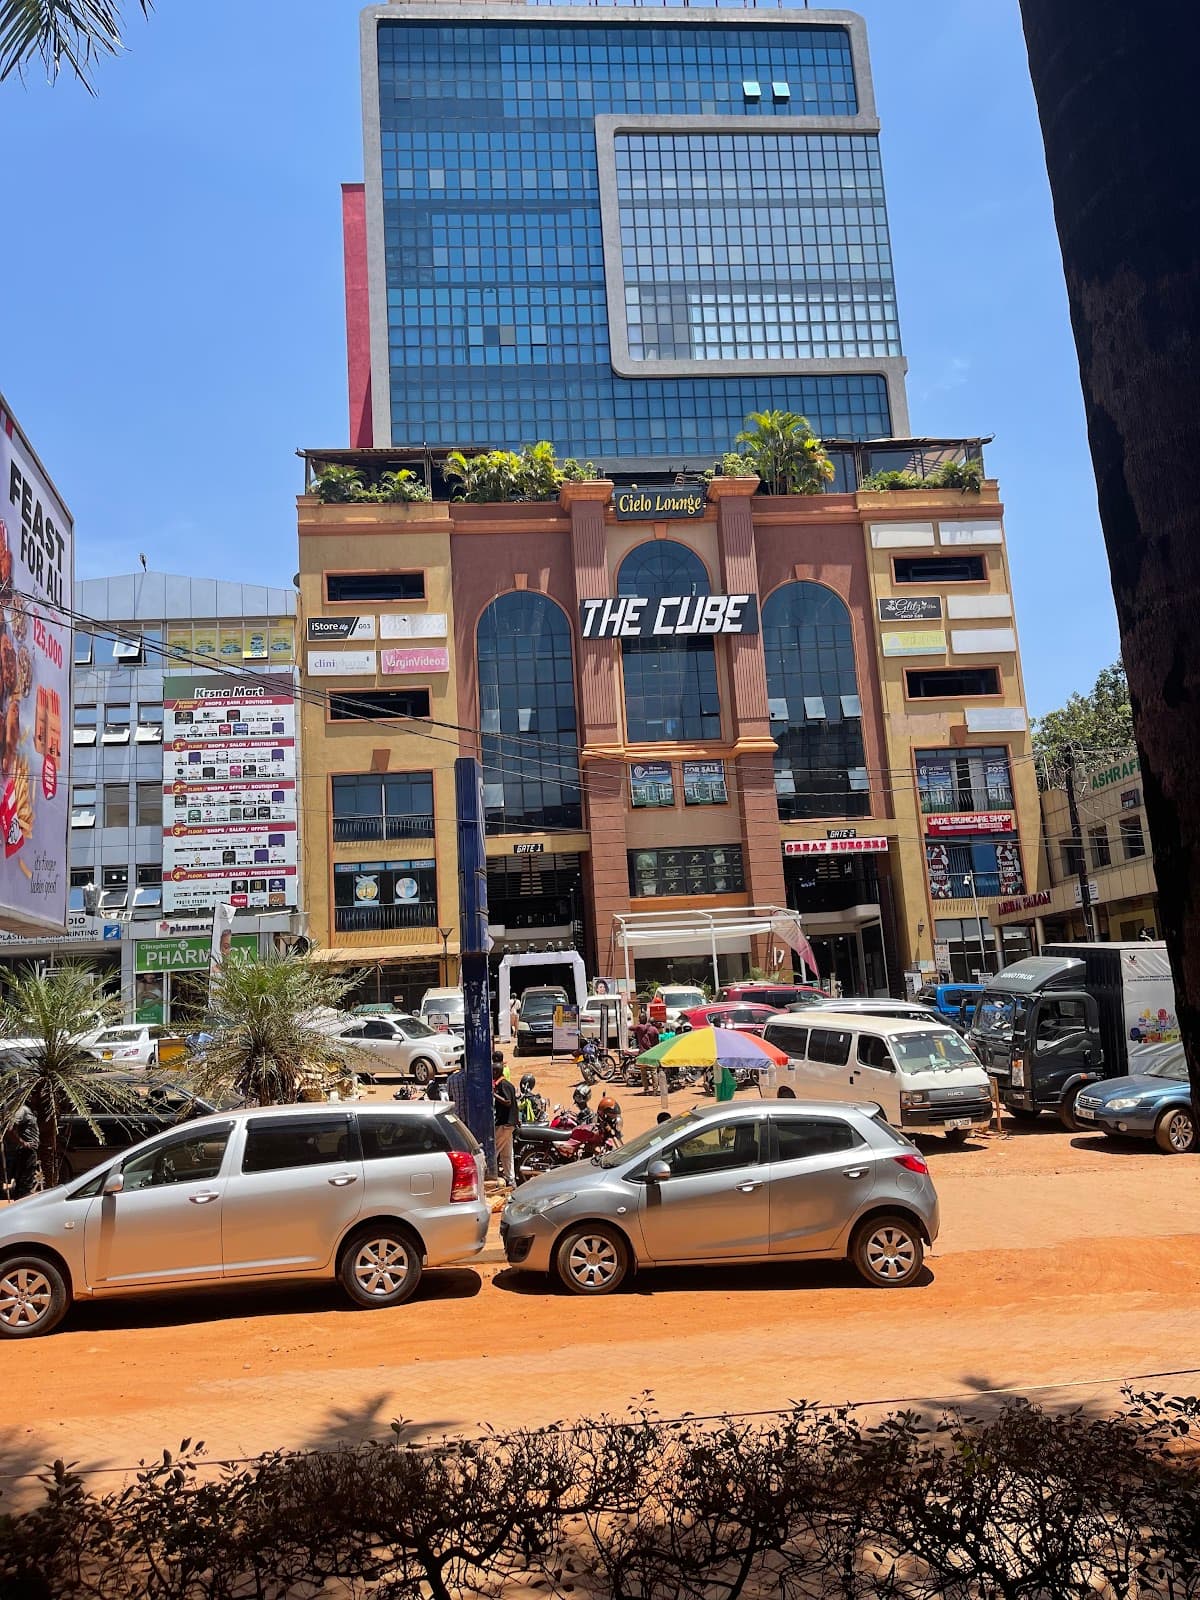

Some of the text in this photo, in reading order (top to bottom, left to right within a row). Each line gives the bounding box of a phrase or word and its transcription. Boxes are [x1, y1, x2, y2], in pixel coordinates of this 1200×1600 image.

[618, 494, 702, 515] Cielo Lounge
[9, 458, 65, 573] FEAST
[21, 523, 63, 608] FOR ALL
[582, 595, 749, 638] THE CUBE
[311, 622, 339, 631] iStore
[314, 658, 336, 668] clini
[194, 686, 265, 699] Krsna Mart
[928, 816, 951, 826] JADE
[988, 814, 1011, 823] SHOP
[829, 830, 847, 839] GATE
[516, 844, 541, 853] GATE 1
[786, 840, 887, 853] GREAT BURGERS
[146, 946, 252, 966] PHARMCY
